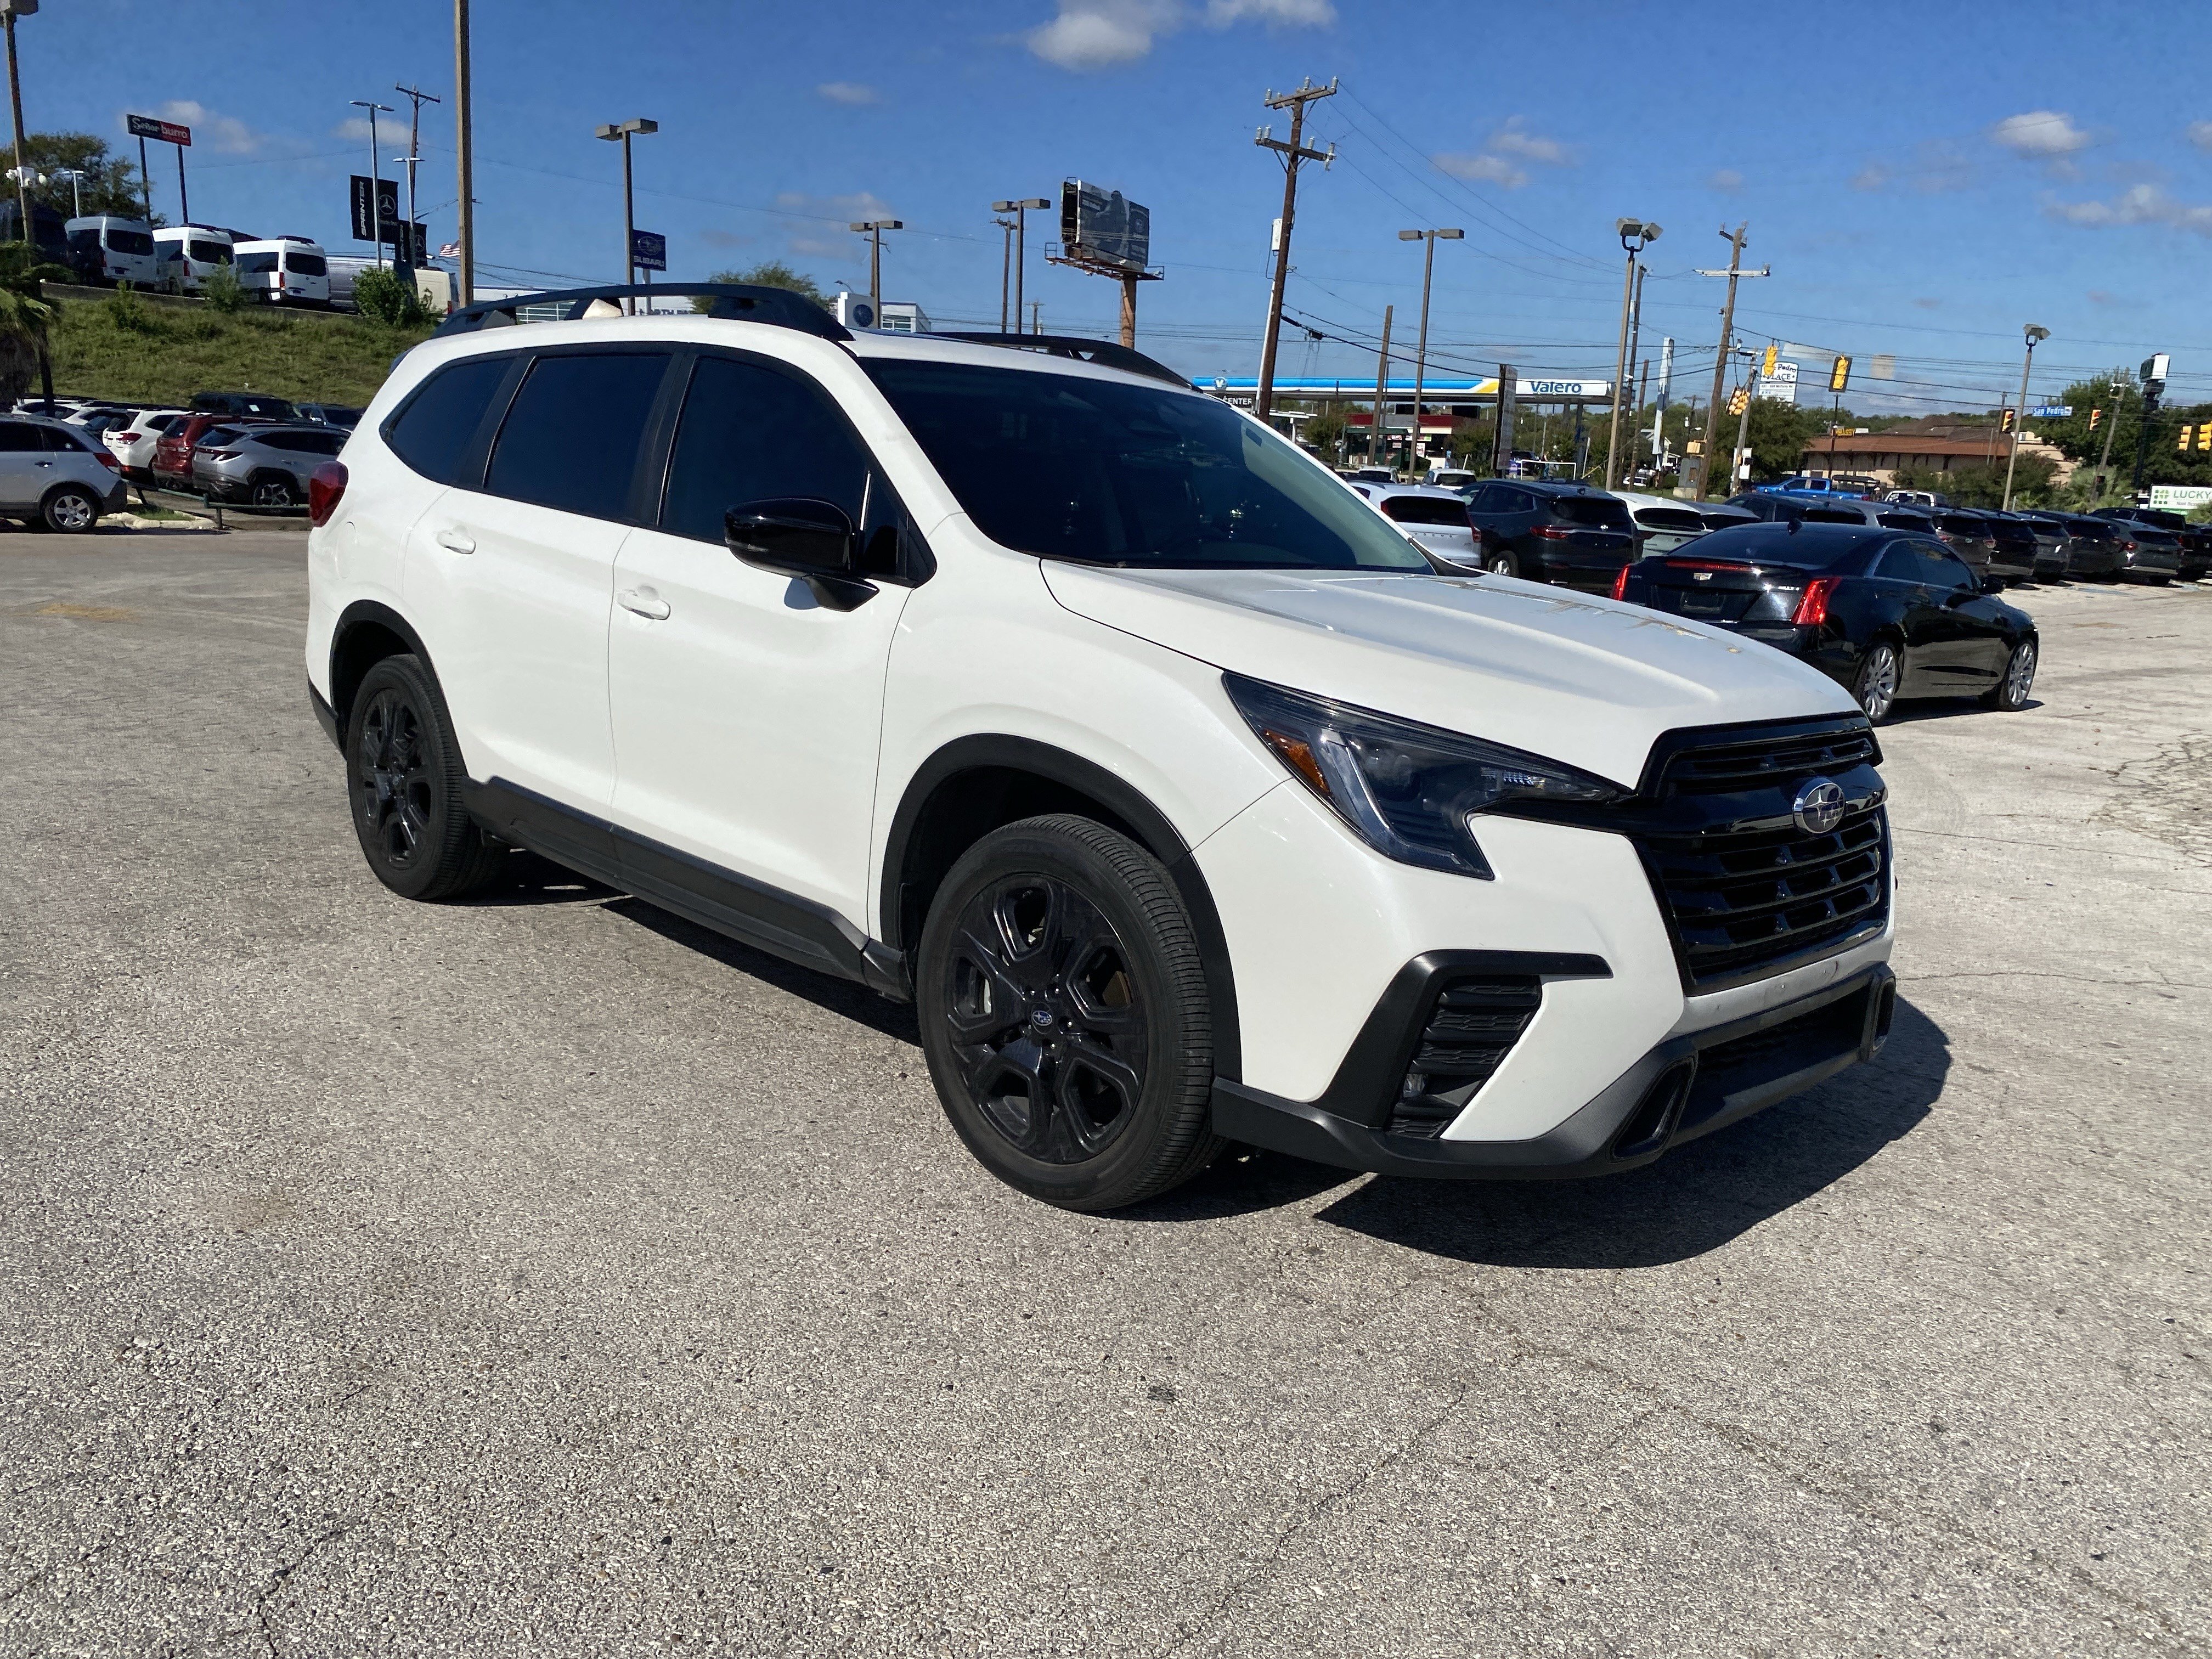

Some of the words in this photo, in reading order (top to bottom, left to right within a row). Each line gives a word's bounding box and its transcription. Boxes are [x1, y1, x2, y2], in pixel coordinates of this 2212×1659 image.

[161, 124, 188, 138] burro
[633, 255, 665, 267] SUBARU
[1531, 381, 1582, 393] Valero
[2034, 407, 2045, 415] San
[2047, 407, 2064, 415] Pedro
[2174, 490, 2211, 499] LUCKY
